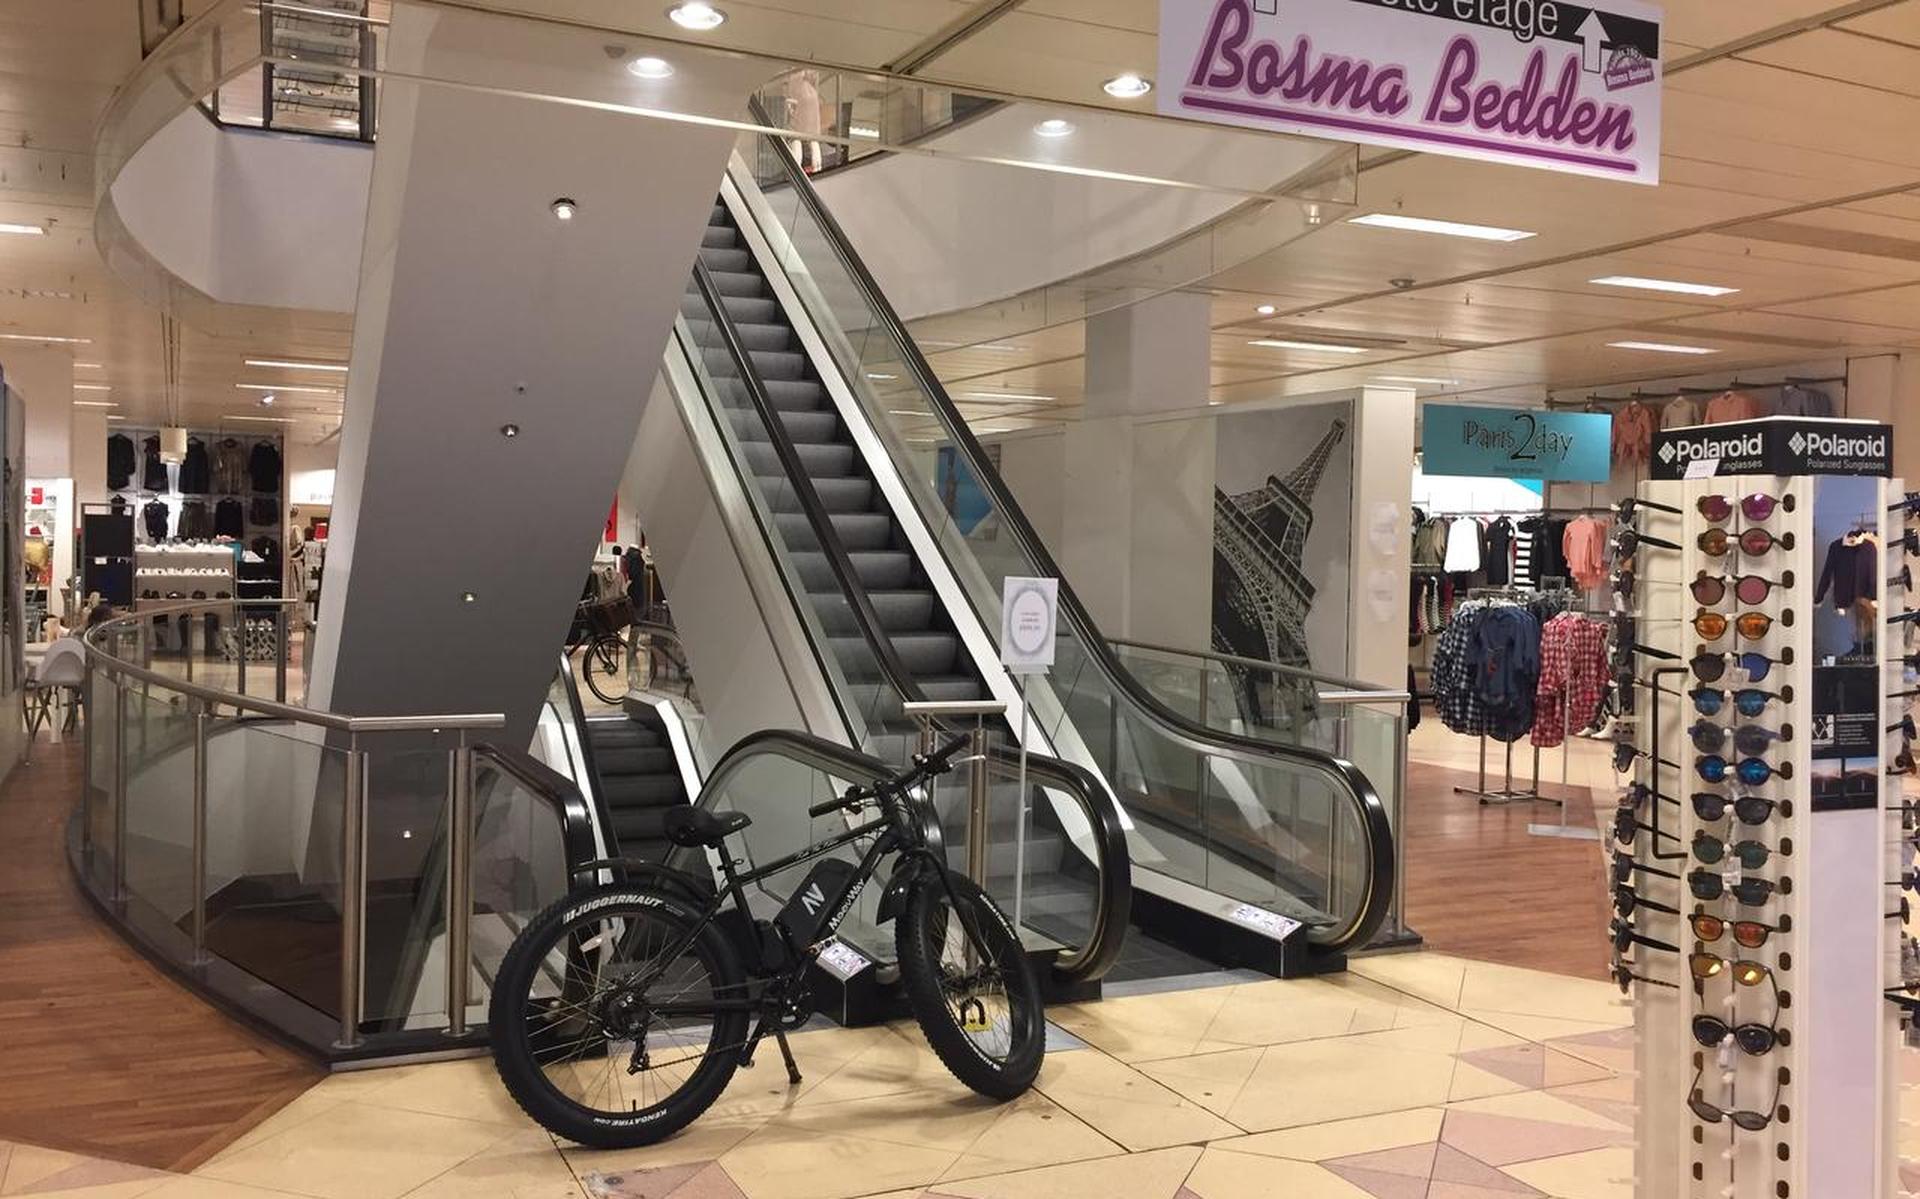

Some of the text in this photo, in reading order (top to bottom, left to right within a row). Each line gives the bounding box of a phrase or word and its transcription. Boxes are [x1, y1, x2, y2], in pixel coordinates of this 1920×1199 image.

[1189, 0, 1637, 151] Bosma Bedden
[1676, 432, 1763, 462] Polaroid
[1807, 432, 1885, 457] Polaroid
[1807, 458, 1885, 471] Polarized Sunglasses
[575, 894, 664, 917] JUGGERNAUT
